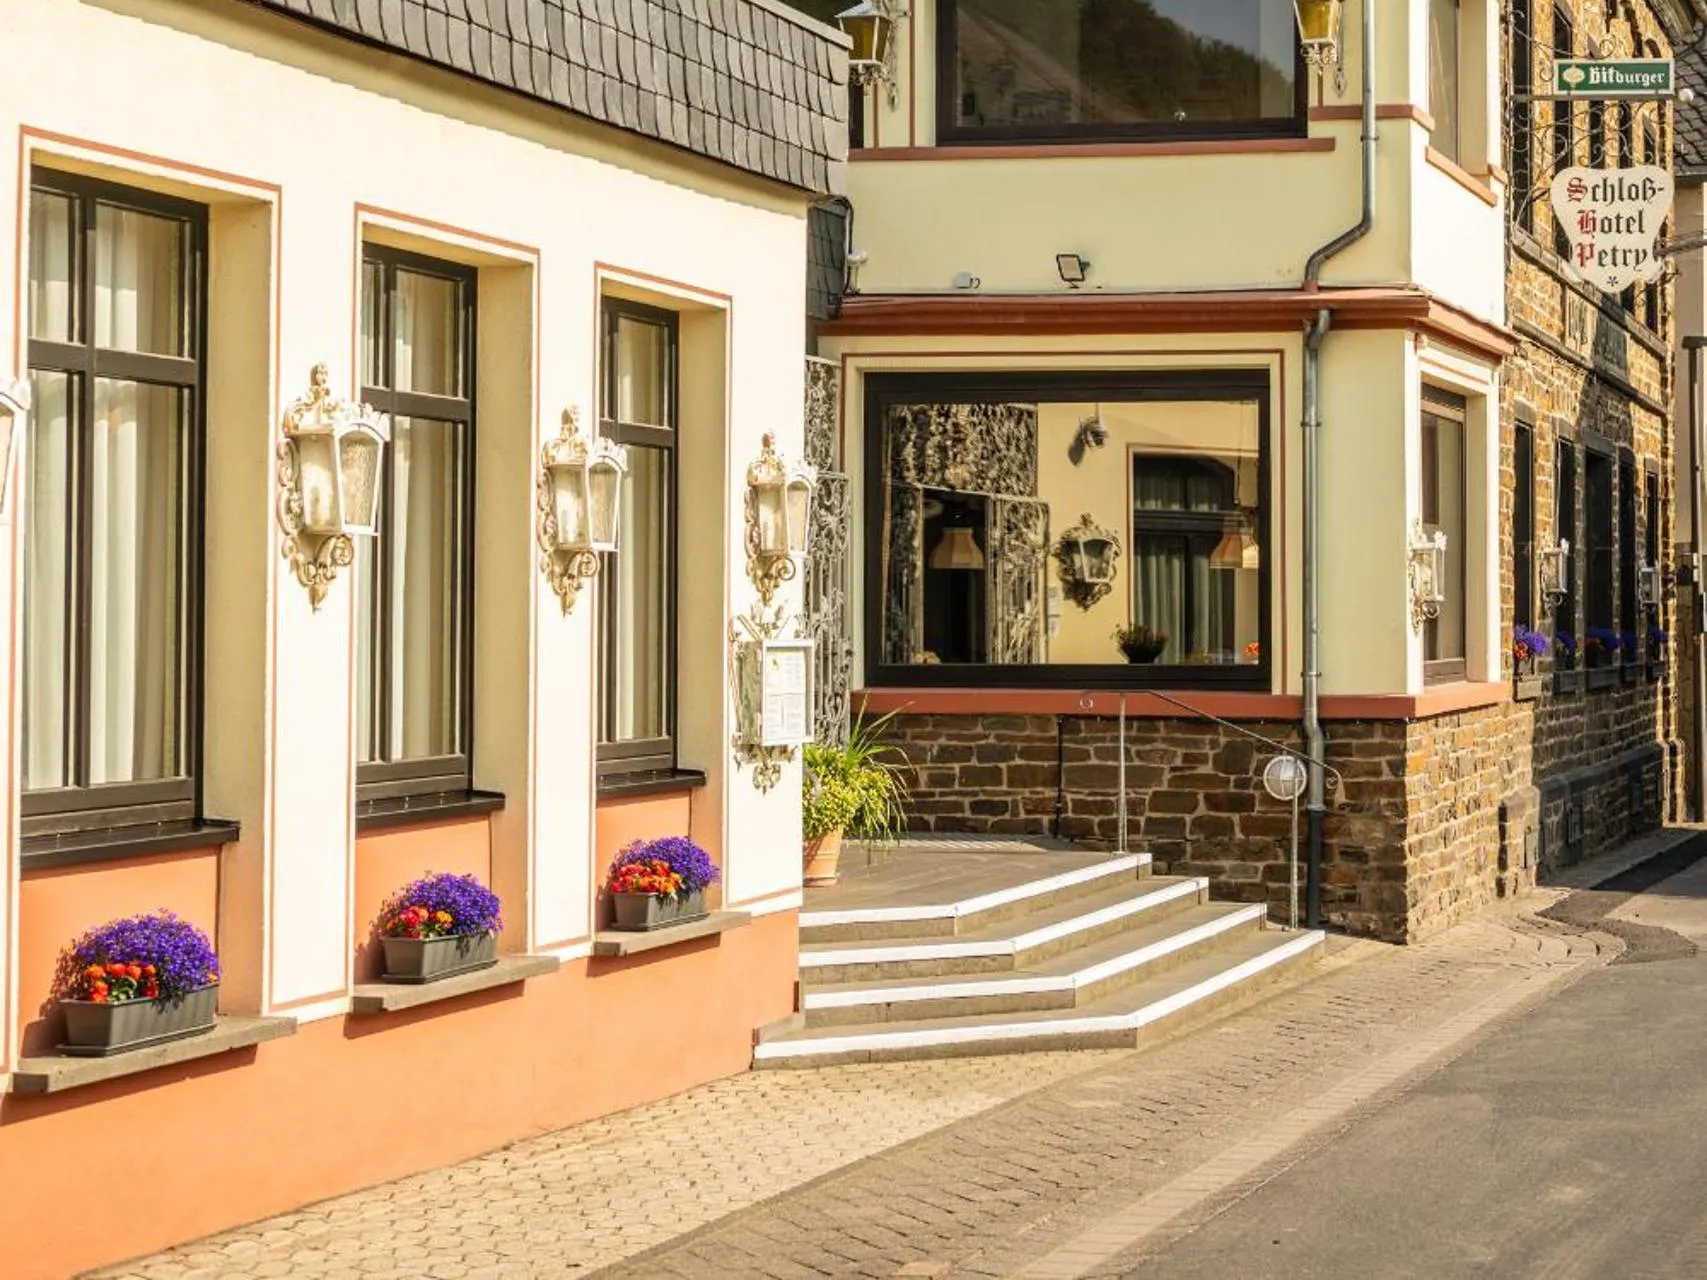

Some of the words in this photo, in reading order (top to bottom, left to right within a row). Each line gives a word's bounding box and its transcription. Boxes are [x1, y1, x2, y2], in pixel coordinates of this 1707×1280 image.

[1588, 66, 1665, 87] Bitburger
[1566, 176, 1664, 206] Schloß-
[1577, 208, 1645, 239] Hotel
[1576, 241, 1648, 271] Petry
